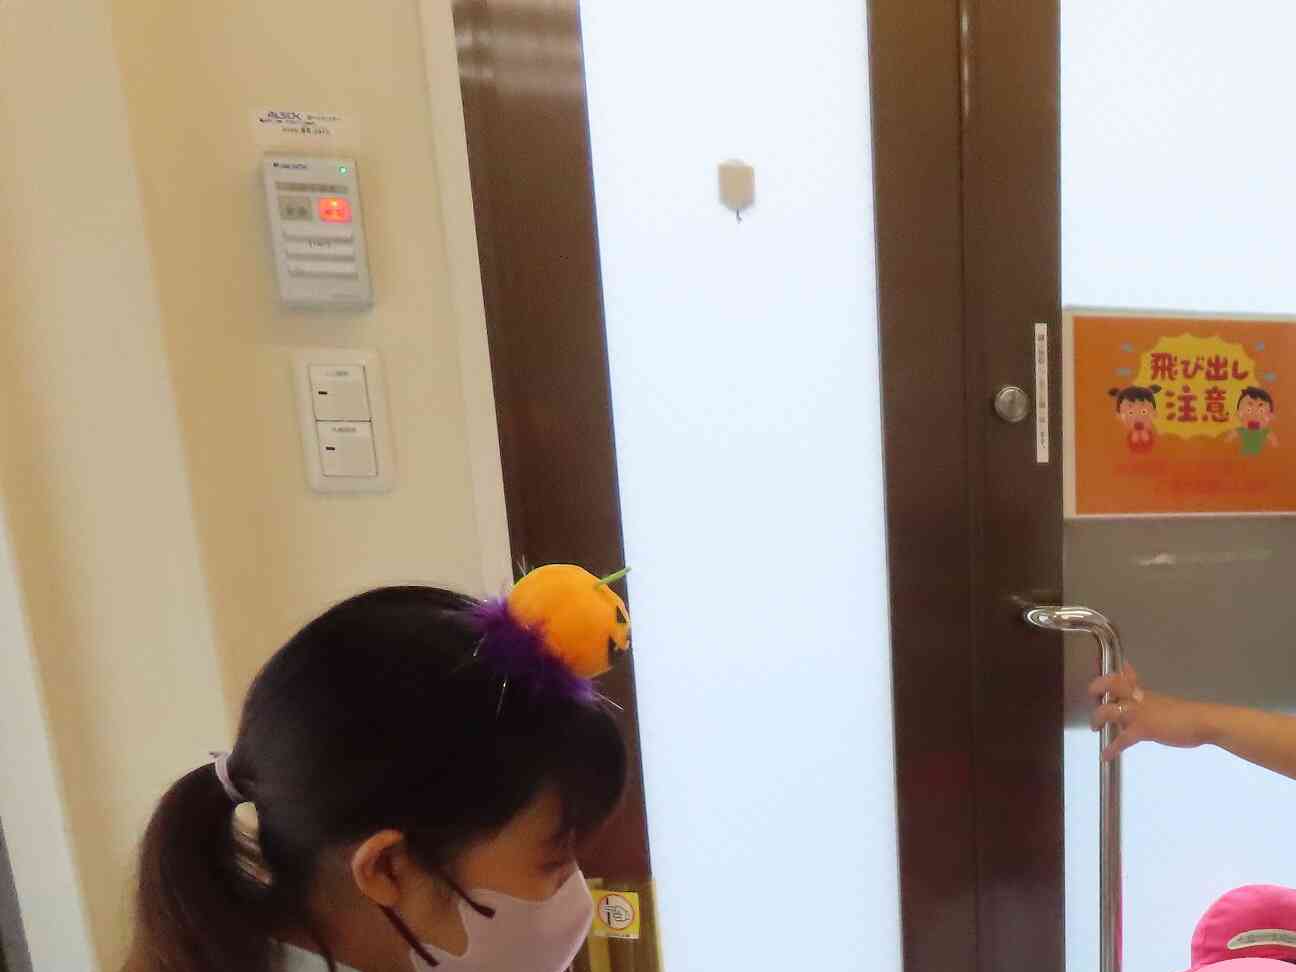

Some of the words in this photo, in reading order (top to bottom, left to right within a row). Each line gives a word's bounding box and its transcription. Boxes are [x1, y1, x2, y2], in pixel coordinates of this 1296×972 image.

[1150, 352, 1249, 381] 飛び出し
[1165, 384, 1230, 422] 注意
